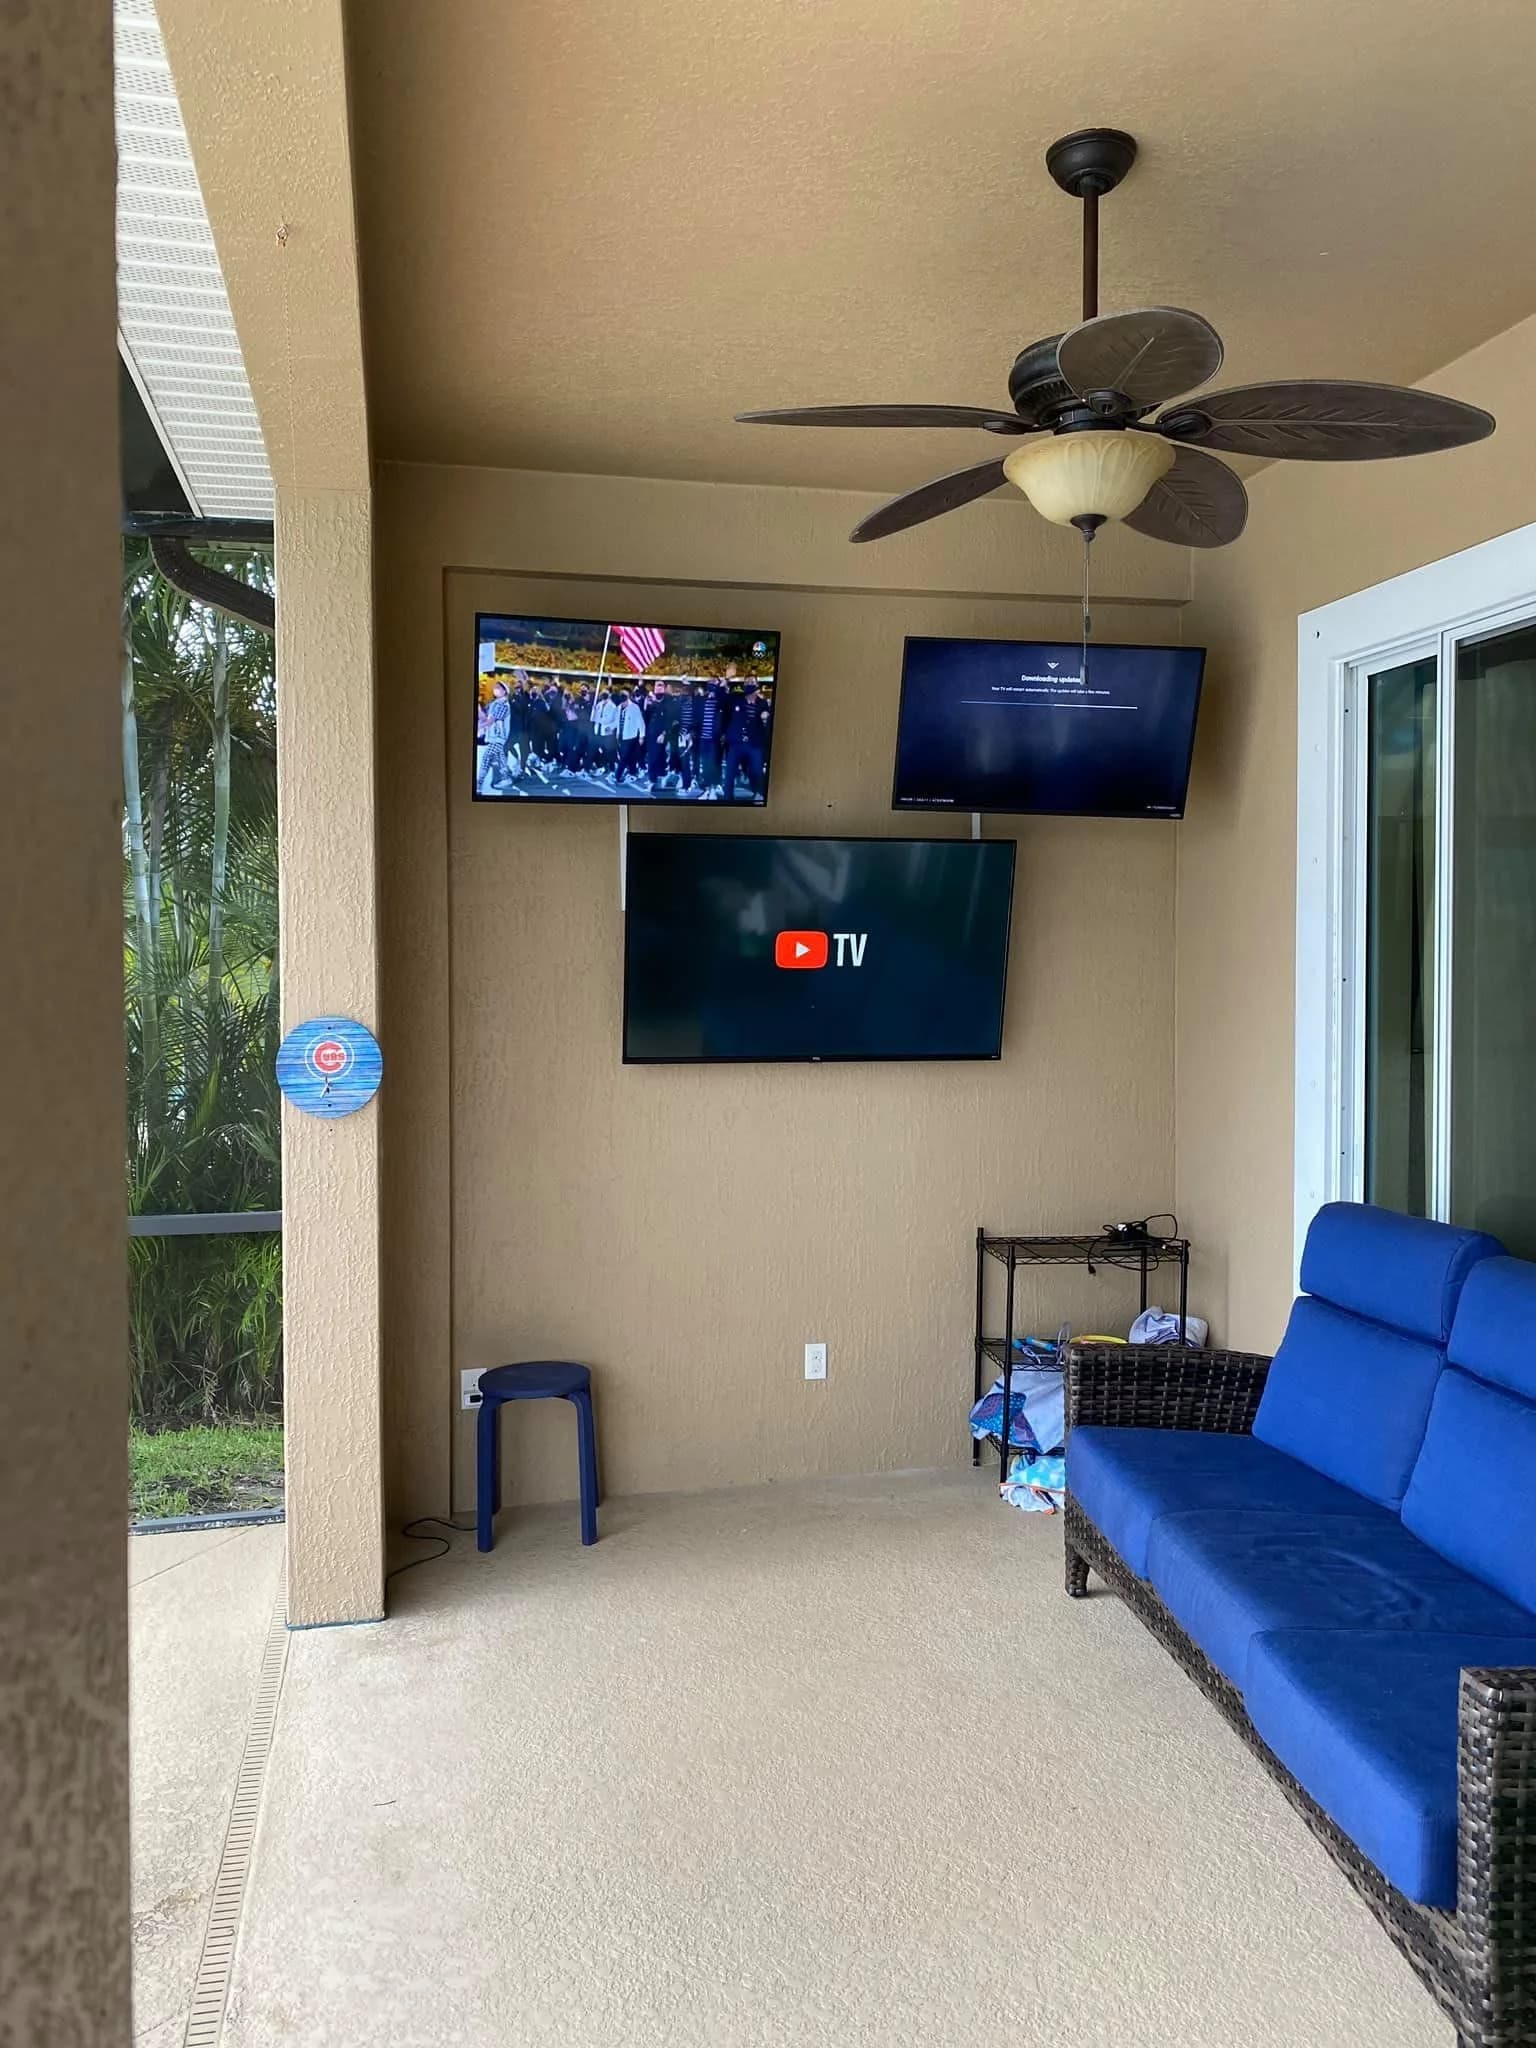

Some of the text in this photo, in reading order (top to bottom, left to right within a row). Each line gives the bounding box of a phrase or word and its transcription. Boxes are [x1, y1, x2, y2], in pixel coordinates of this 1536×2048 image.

[1021, 674, 1058, 683] Downloading
[833, 933, 868, 967] TV
[313, 1040, 347, 1073] CUBS
